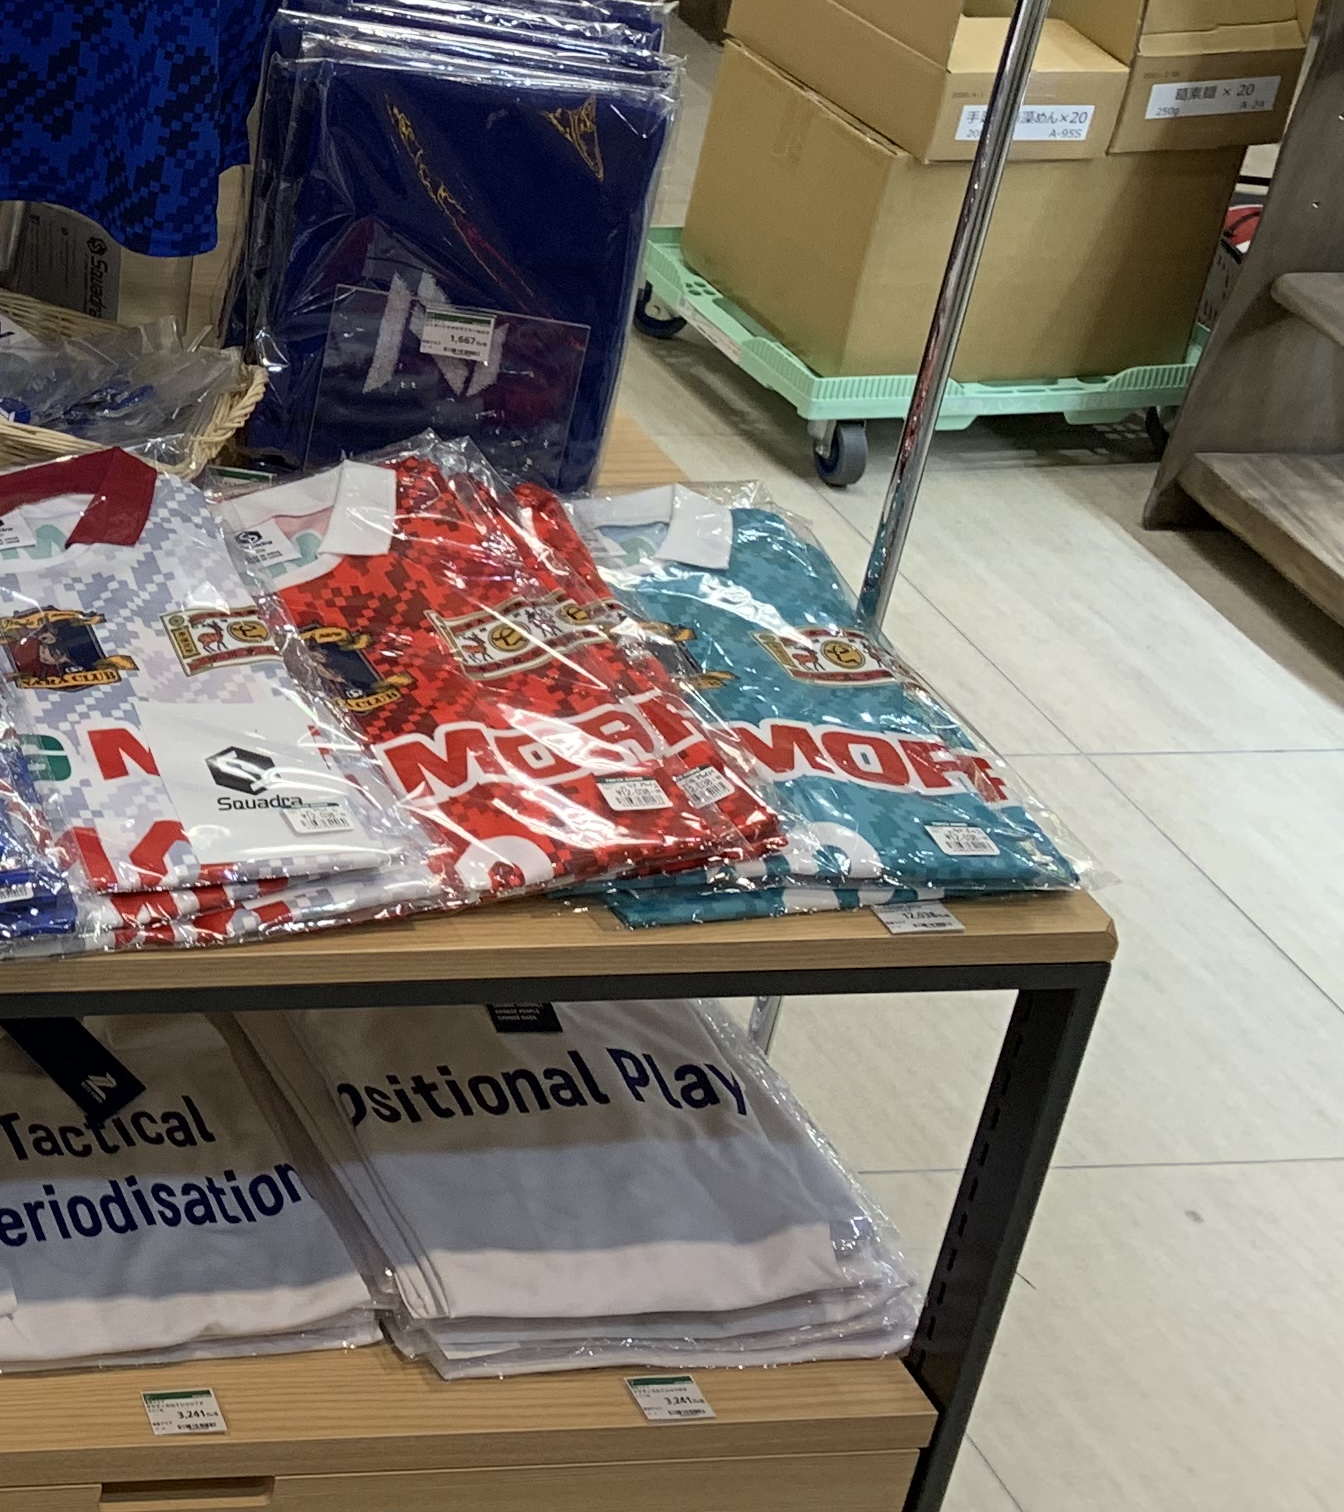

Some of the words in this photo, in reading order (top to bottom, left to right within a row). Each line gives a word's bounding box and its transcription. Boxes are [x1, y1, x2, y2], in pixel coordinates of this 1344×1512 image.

[71, 669, 119, 687] CLUB
[217, 794, 304, 812] Squadra
[618, 1046, 752, 1118] Play
